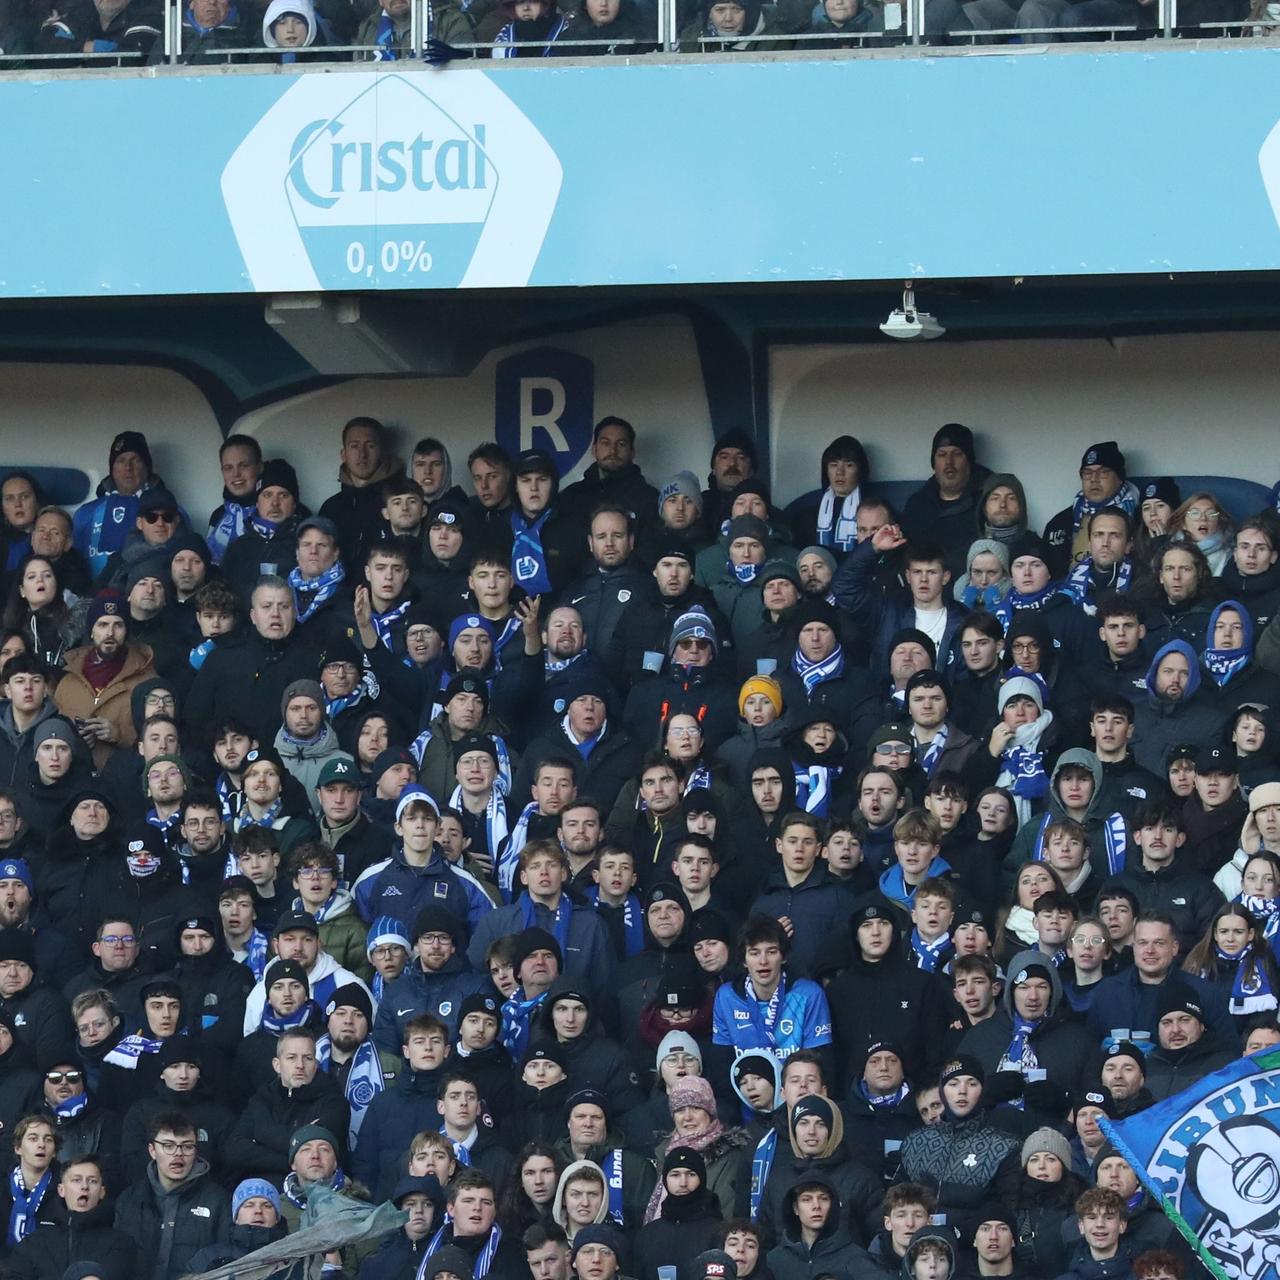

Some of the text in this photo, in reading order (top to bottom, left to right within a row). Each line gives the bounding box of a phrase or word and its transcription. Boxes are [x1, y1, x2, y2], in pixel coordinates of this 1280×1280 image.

[289, 118, 488, 209] Cristal
[346, 240, 433, 278] 0,0%
[520, 376, 570, 453] R
[1212, 749, 1220, 758] C
[733, 1009, 750, 1020] itzu
[706, 1263, 726, 1275] SPS
